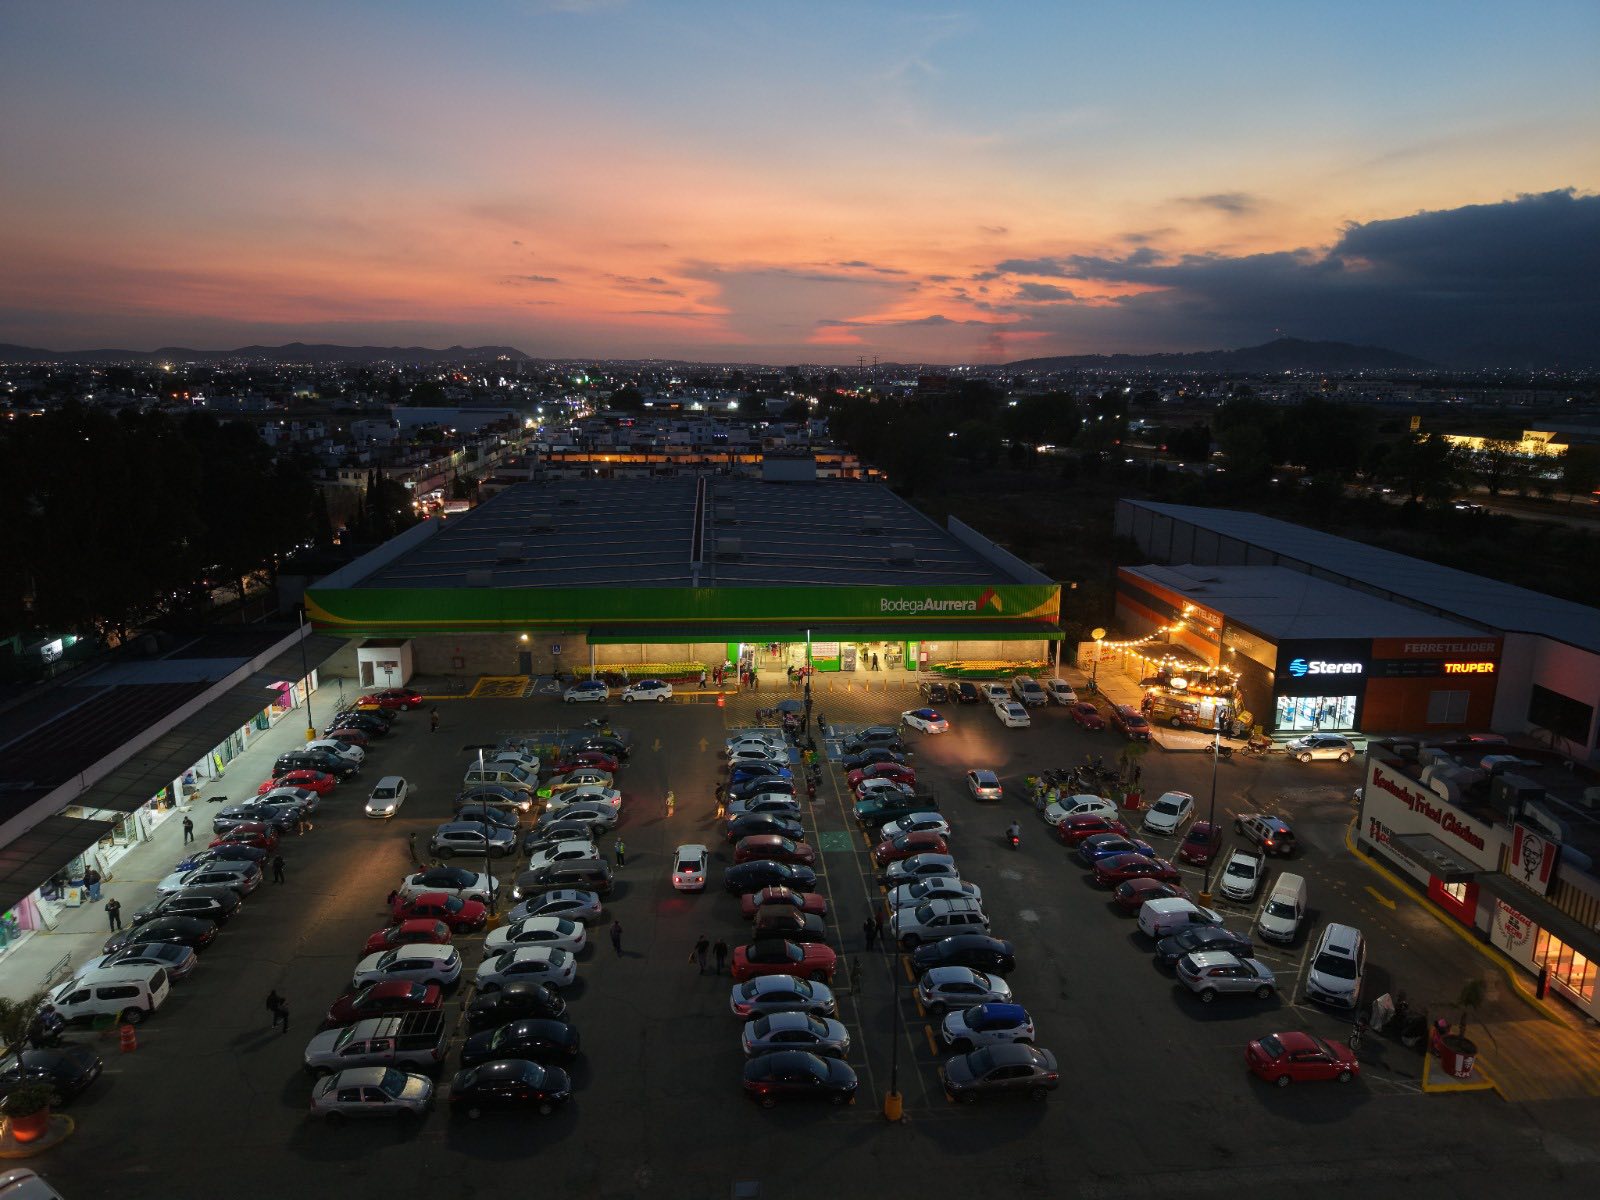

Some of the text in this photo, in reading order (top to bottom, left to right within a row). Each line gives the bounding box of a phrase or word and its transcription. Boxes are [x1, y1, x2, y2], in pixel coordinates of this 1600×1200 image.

[1307, 661, 1362, 674] Steren
[1444, 663, 1494, 673] TRUPER
[1372, 767, 1484, 851] Kentucky Fried Chicken
